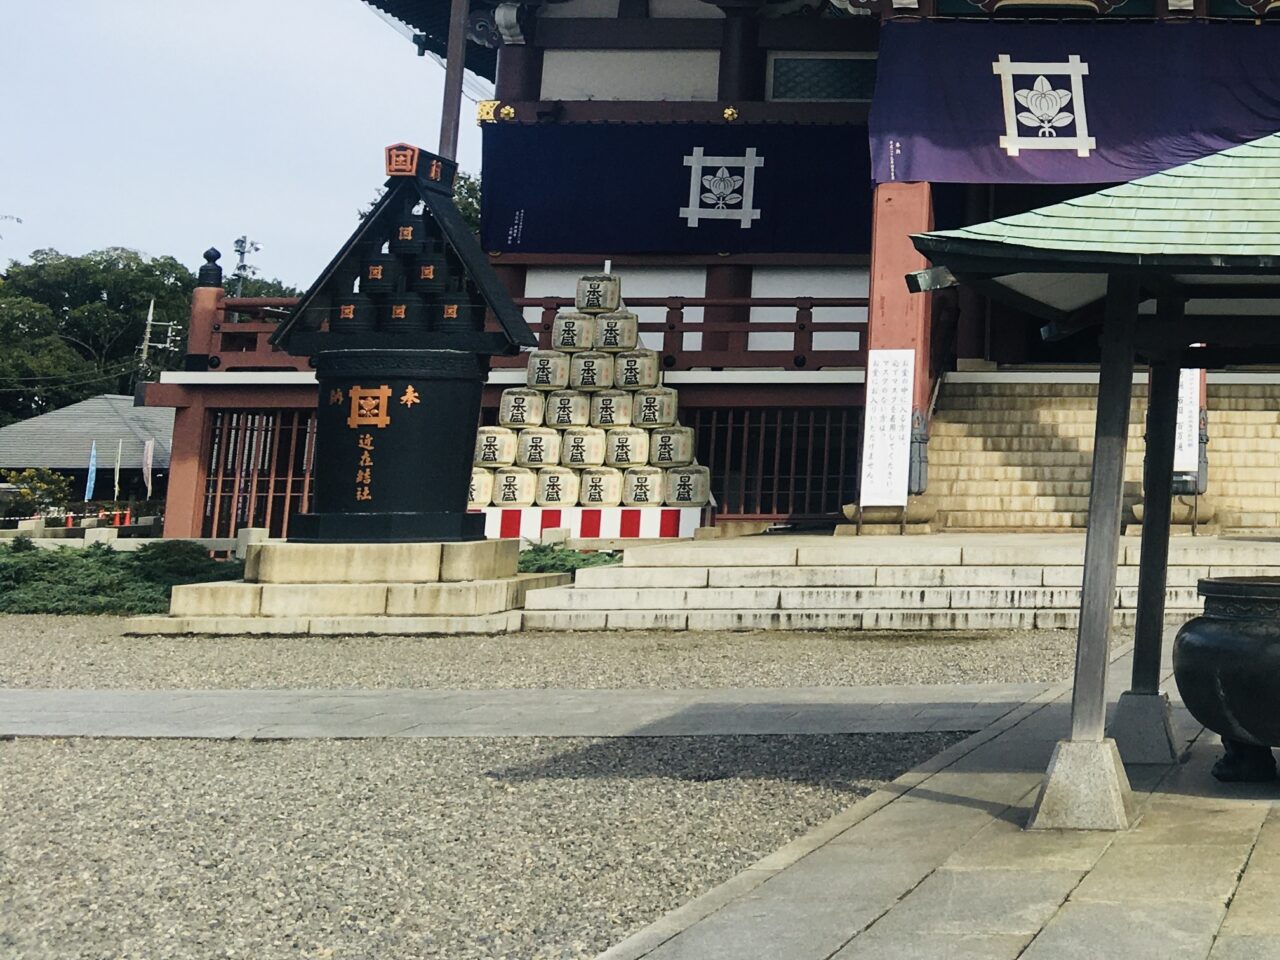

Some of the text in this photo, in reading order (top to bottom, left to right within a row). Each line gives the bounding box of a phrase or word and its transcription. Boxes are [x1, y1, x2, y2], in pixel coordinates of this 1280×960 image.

[587, 283, 602, 308] 日本盛
[562, 321, 576, 347] 日本盛
[604, 321, 619, 346] 日本盛
[536, 359, 551, 384] 日本盛
[581, 360, 596, 385] 日本盛
[623, 359, 639, 385] 日本盛
[400, 384, 421, 409] 奉
[511, 397, 526, 423] 日本盛
[556, 398, 572, 424] 日本盛
[600, 398, 614, 423] 日本盛
[642, 397, 657, 422] 日本盛
[482, 436, 498, 462] 日本盛
[528, 437, 544, 462] 日本盛
[570, 437, 585, 462] 日本盛
[616, 437, 631, 462] 日本盛
[658, 436, 673, 461] 日本盛
[355, 433, 375, 501] 近在結社
[502, 476, 518, 502] 日本盛
[546, 476, 561, 502] 日本盛
[589, 477, 604, 502] 日本盛
[634, 476, 649, 502] 日本盛
[677, 475, 693, 501] 日本盛
